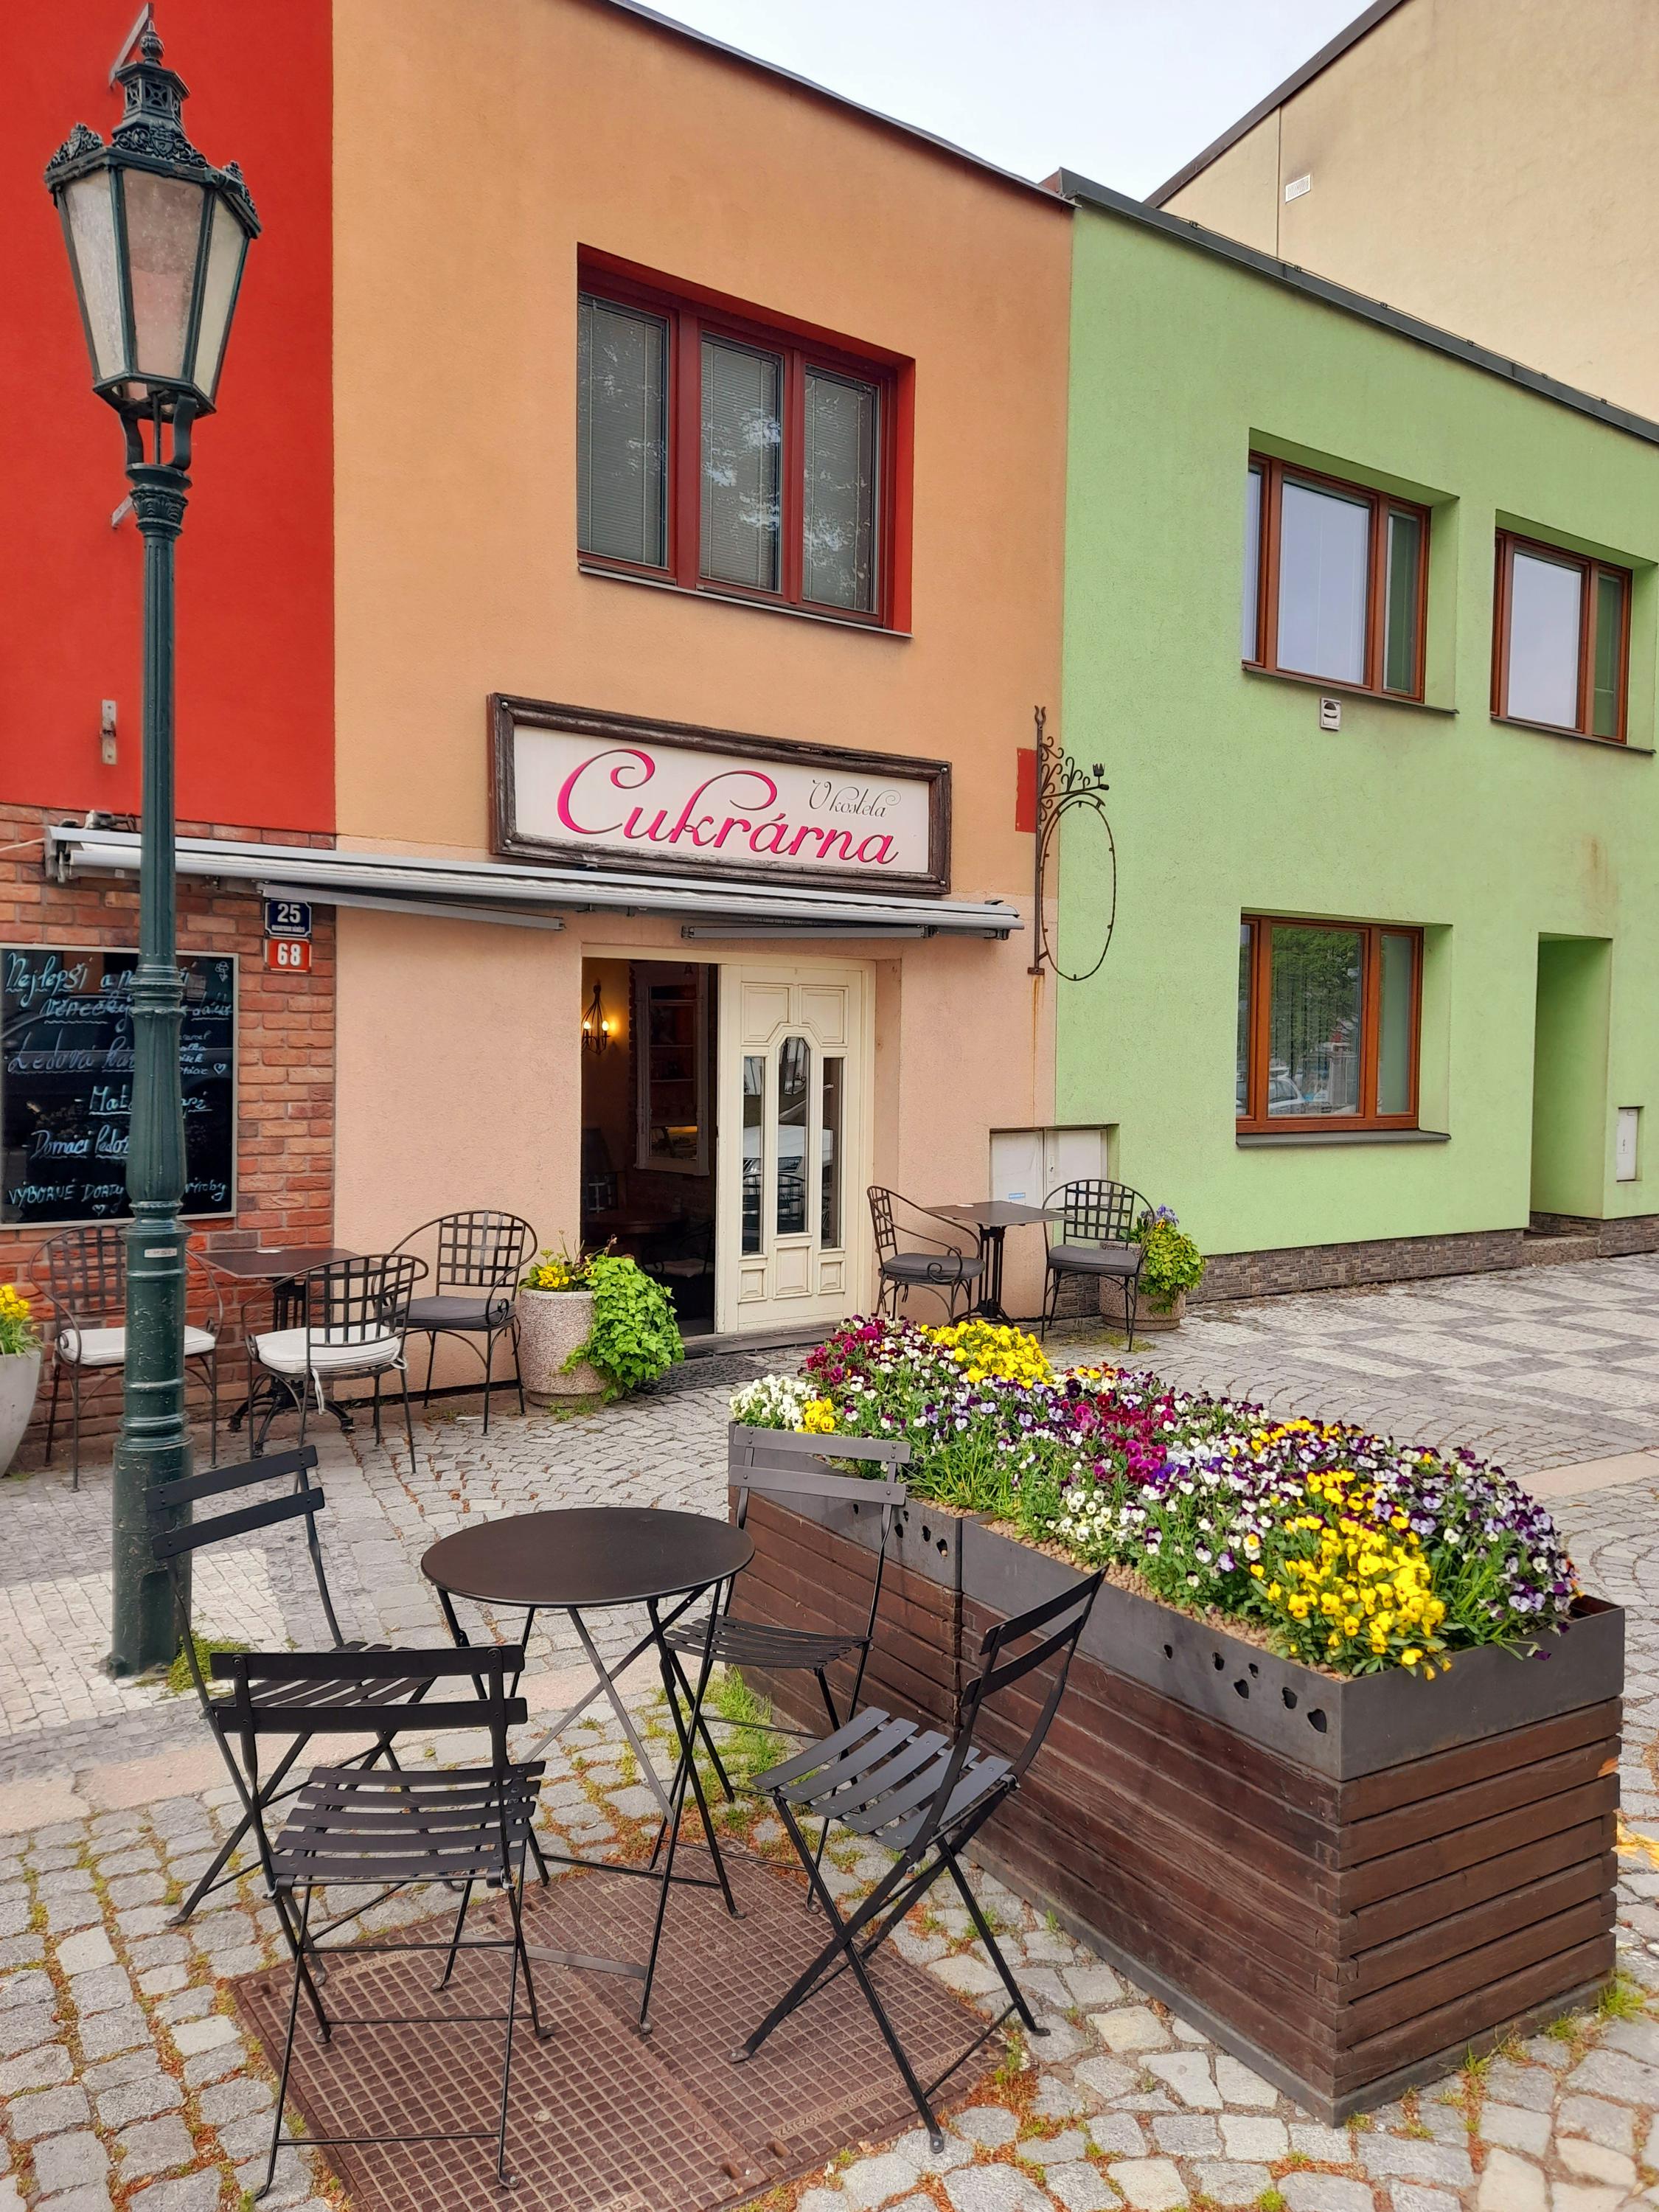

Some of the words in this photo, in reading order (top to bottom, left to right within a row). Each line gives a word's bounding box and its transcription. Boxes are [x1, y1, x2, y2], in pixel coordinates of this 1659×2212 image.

[557, 748, 899, 865] Cukrárna
[829, 786, 901, 818] kostela
[277, 903, 302, 923] 25
[277, 943, 302, 966] 68
[6, 952, 93, 1008] Nejlepší
